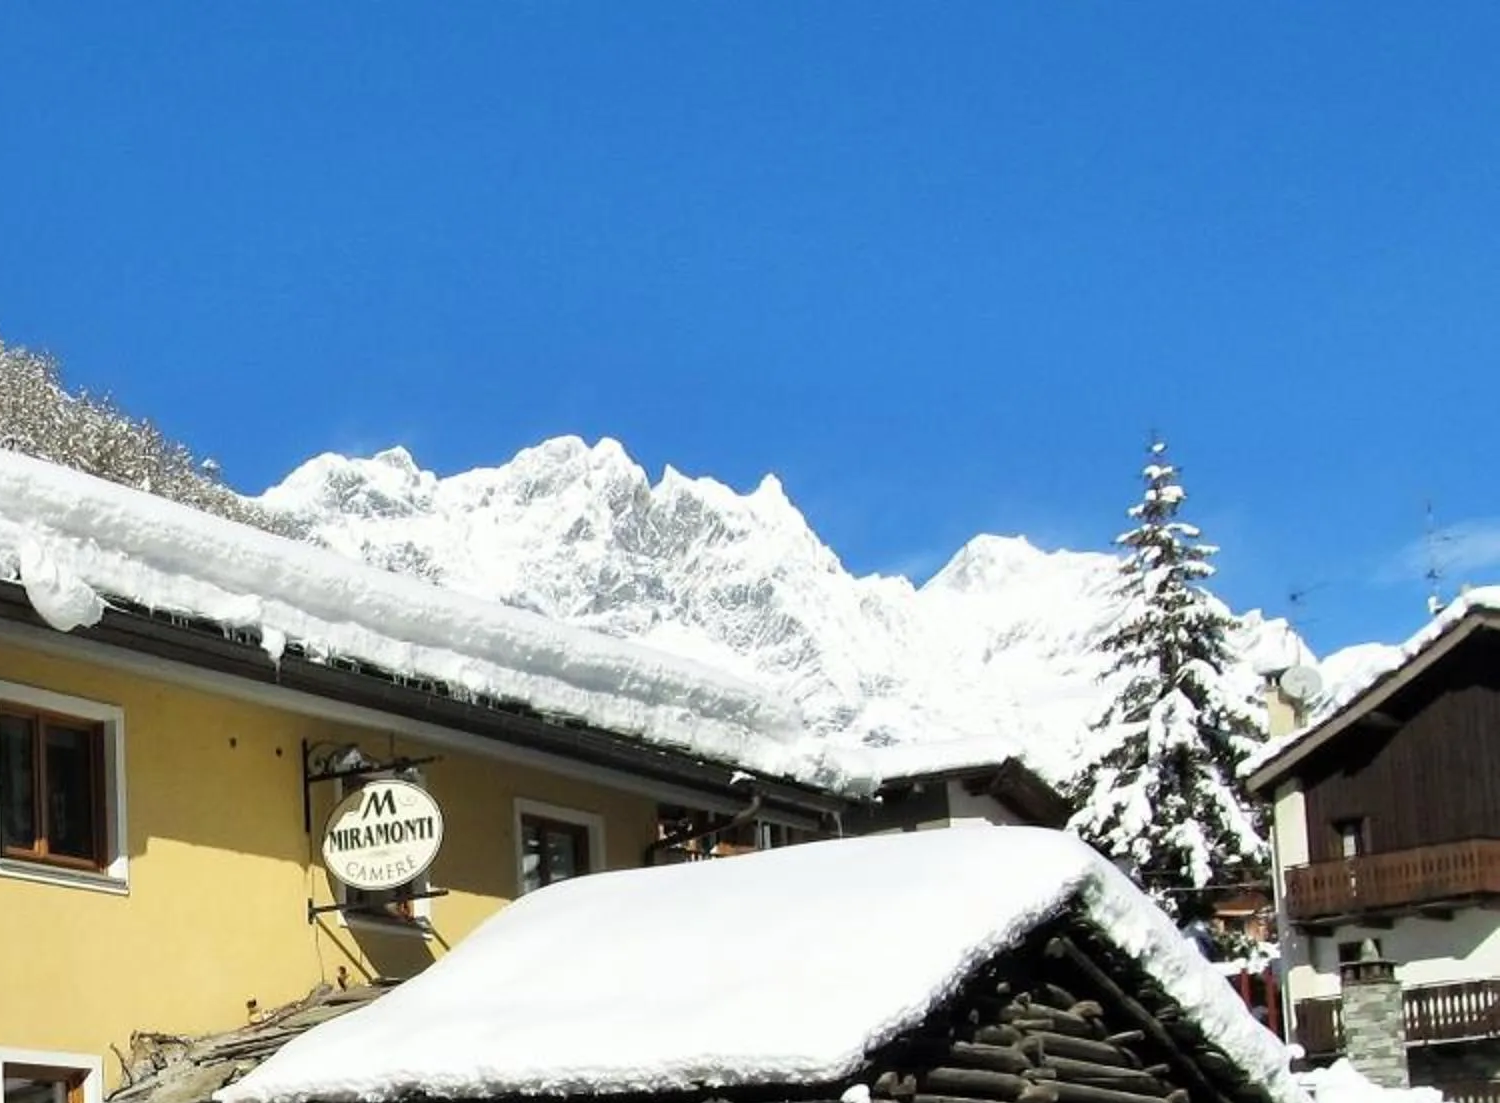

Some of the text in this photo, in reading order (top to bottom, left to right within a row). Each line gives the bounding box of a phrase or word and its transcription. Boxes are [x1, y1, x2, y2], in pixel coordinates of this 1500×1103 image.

[362, 789, 397, 820] M
[329, 816, 433, 853] MIRAMONTI
[346, 856, 418, 881] CAMERE
